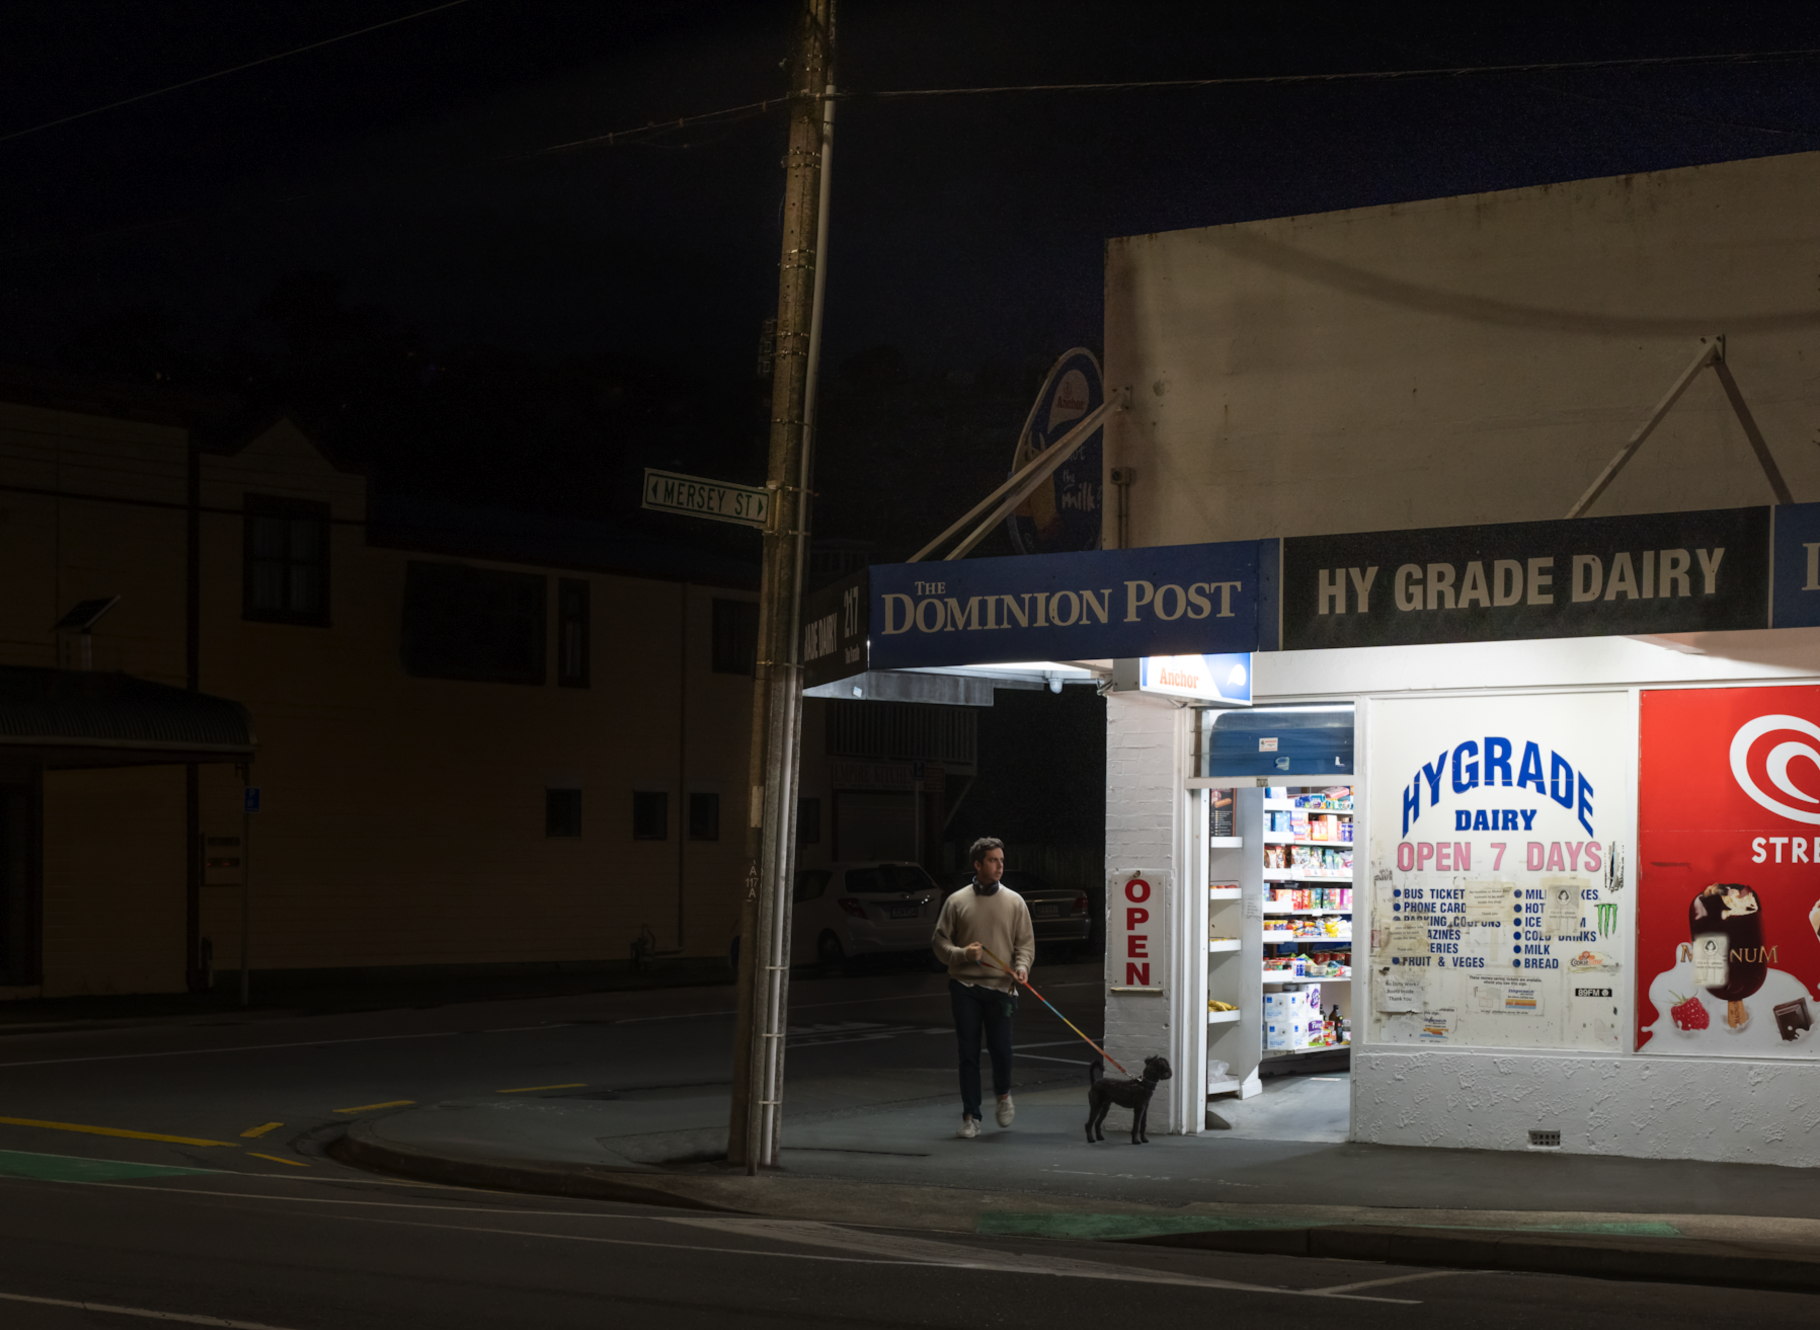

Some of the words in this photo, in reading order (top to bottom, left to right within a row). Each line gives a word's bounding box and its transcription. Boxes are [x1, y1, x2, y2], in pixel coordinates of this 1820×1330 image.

[1057, 396, 1085, 411] Anchor
[664, 481, 726, 512] MERSEY
[735, 493, 752, 517] ST
[915, 581, 946, 596] THE
[1318, 566, 1379, 615] HY
[1394, 557, 1555, 612] GRADE
[1572, 547, 1725, 603] DAIRY
[843, 586, 859, 638] 217
[881, 589, 1112, 635] DOMINION
[1123, 580, 1242, 622] POST
[818, 612, 837, 657] DAIRY
[1159, 667, 1199, 689] Anchor
[834, 765, 870, 783] EMPIRE
[1402, 736, 1594, 839] HYGRADE
[1455, 809, 1537, 831] DAIRY
[1397, 842, 1471, 872] OPEN
[1490, 842, 1507, 871] 7
[1526, 841, 1602, 872] DAYS
[745, 877, 759, 887] 117
[1404, 889, 1424, 899] BUS
[1525, 889, 1547, 900] MIL
[1404, 902, 1437, 913] PHONE
[1525, 903, 1546, 914] HOT
[1525, 917, 1542, 927] ICE
[1124, 879, 1151, 986] OPEN
[1524, 944, 1550, 955] MILK
[1681, 944, 1778, 964] MNUM
[1403, 956, 1431, 967] FRUIT
[1438, 957, 1445, 967] &
[1452, 957, 1485, 968] VEGES
[1524, 958, 1559, 969] BREAD
[1578, 989, 1600, 997] 89FM
